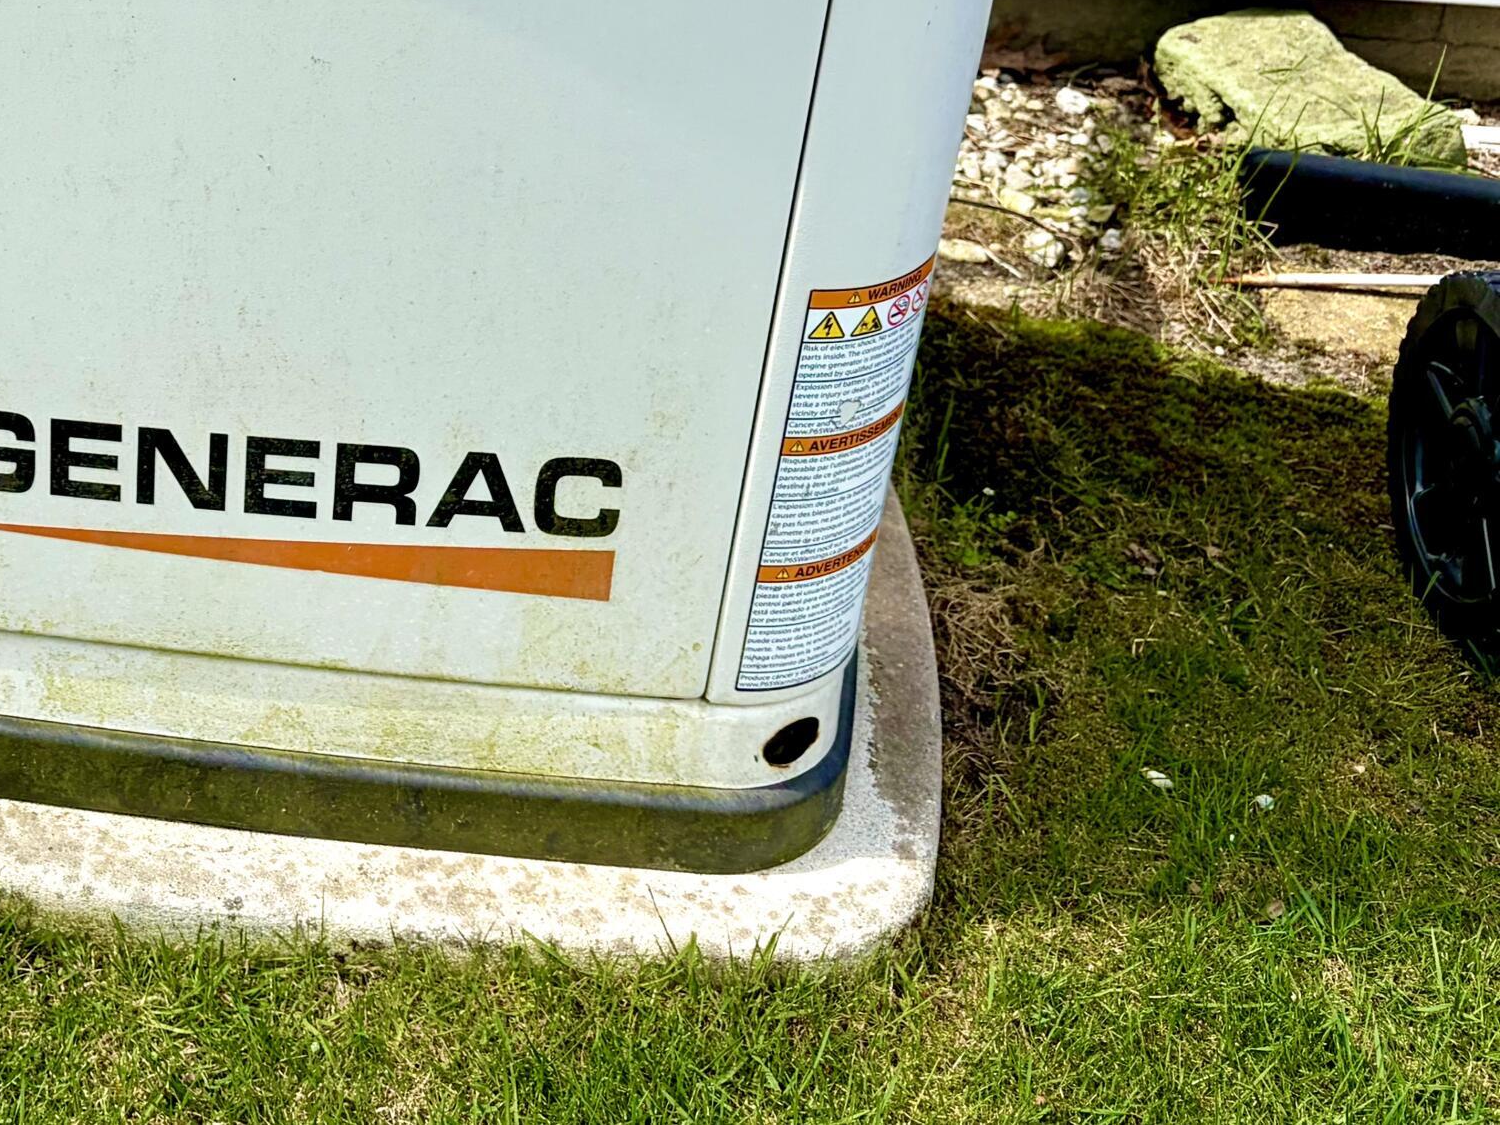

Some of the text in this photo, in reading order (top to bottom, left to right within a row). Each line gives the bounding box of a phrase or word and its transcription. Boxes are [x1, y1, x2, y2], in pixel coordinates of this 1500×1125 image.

[868, 270, 922, 300] WARNING
[830, 342, 855, 351] electric
[801, 352, 821, 361] parts
[848, 350, 860, 358] The
[800, 362, 827, 371] engine
[827, 358, 863, 370] generator
[844, 364, 873, 377] qualified
[795, 383, 833, 391] Explosion
[842, 377, 866, 389] battery
[820, 390, 841, 399] injury
[792, 400, 813, 409] strike
[791, 409, 818, 417] vicinity
[788, 420, 815, 428] Cancer
[782, 520, 795, 528] pas
[763, 549, 790, 557] Cancer
[769, 606, 805, 616] destinado
